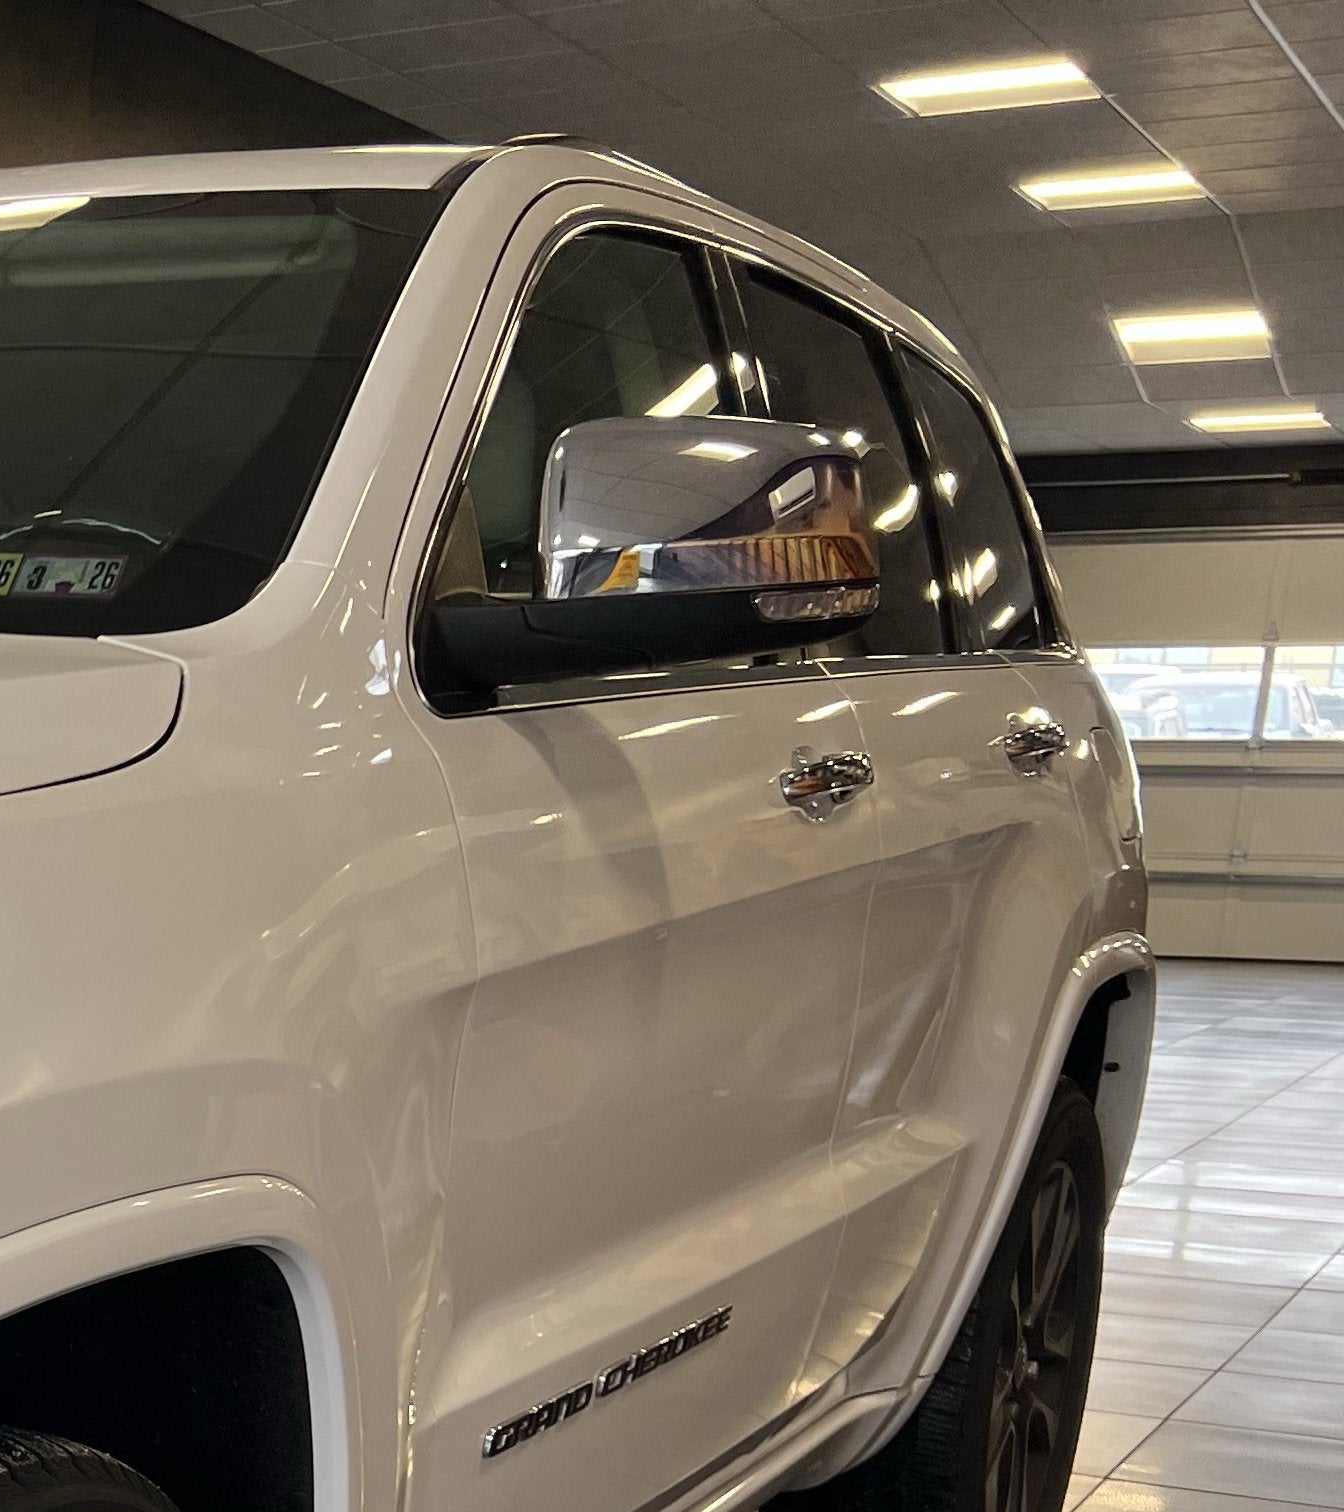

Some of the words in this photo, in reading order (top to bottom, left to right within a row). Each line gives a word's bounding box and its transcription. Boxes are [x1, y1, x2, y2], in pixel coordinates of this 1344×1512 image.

[26, 565, 48, 590] 3
[87, 561, 120, 592] 26
[482, 1380, 594, 1458] GRAND
